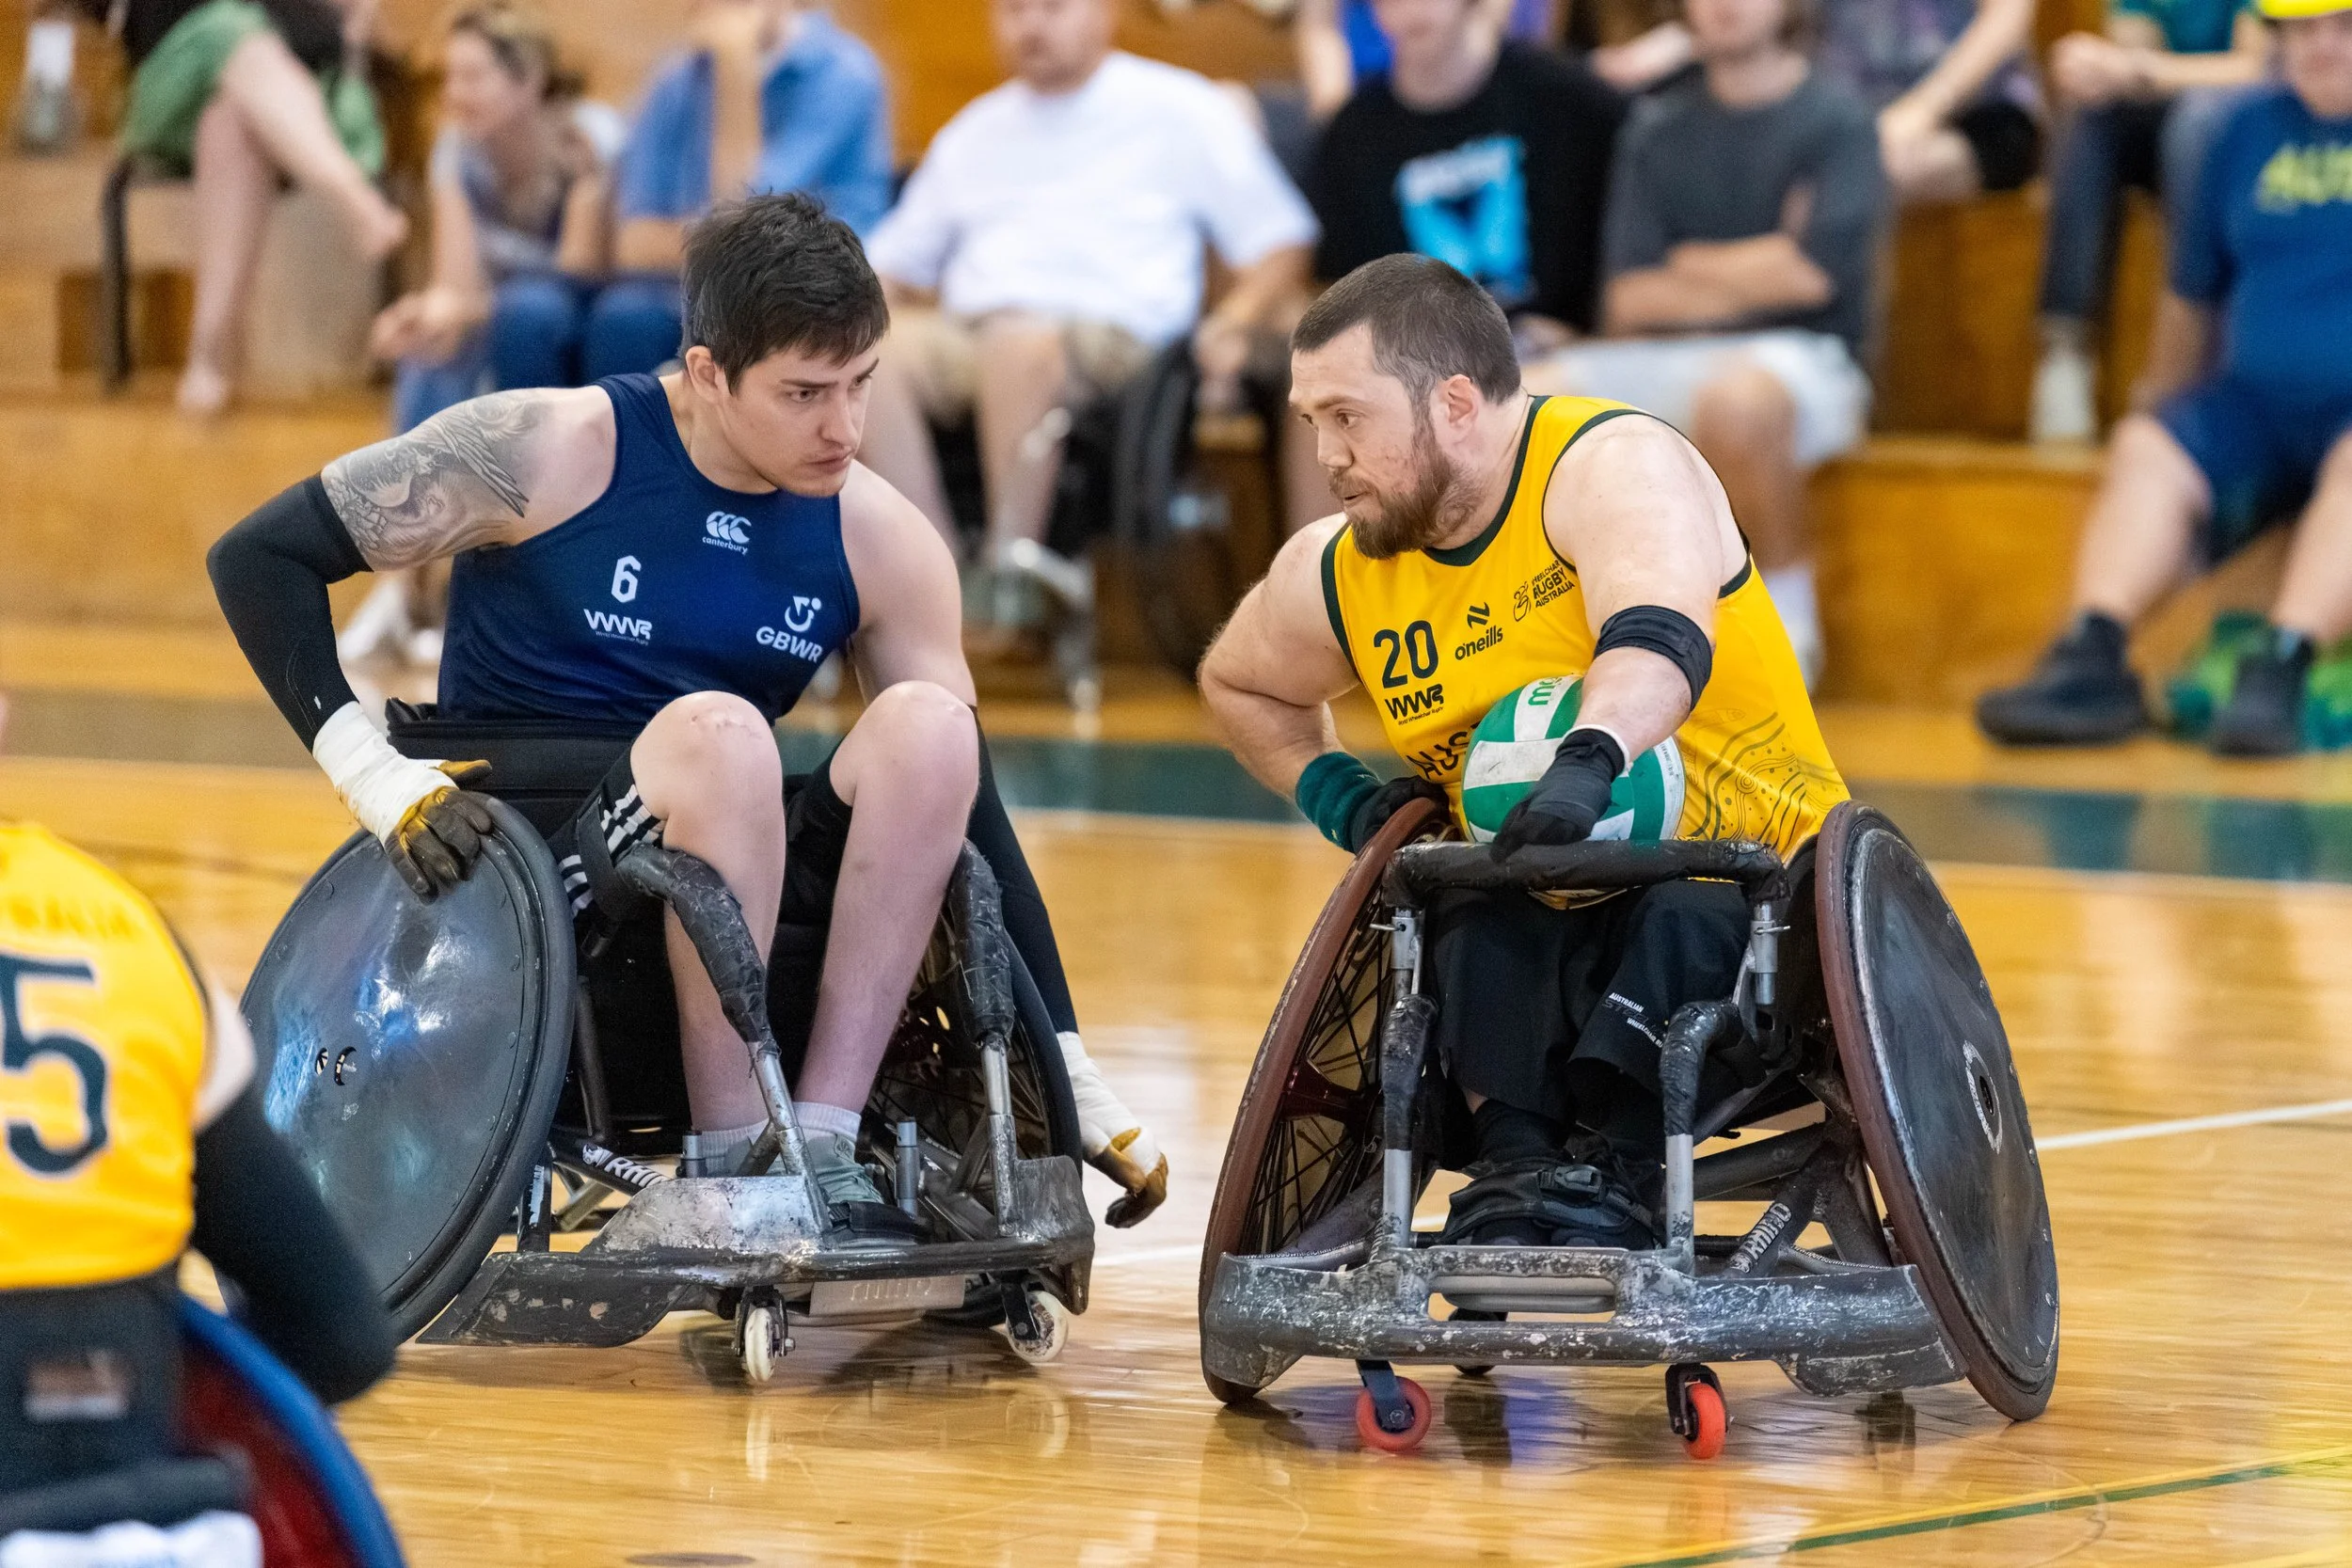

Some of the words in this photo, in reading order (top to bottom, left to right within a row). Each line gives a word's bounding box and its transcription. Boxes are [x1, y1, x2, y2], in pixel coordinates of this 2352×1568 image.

[702, 536, 748, 556] canterbury
[612, 555, 642, 603] 6
[1533, 567, 1567, 599] RUGBY
[1535, 580, 1575, 608] AUSTRALIA
[755, 626, 822, 663] GBWR
[1374, 620, 1438, 689] 20
[1609, 992, 1645, 1013] AUSTRALIAN
[1627, 1018, 1657, 1043] WHEELCHAIR
[0, 953, 109, 1175] 5
